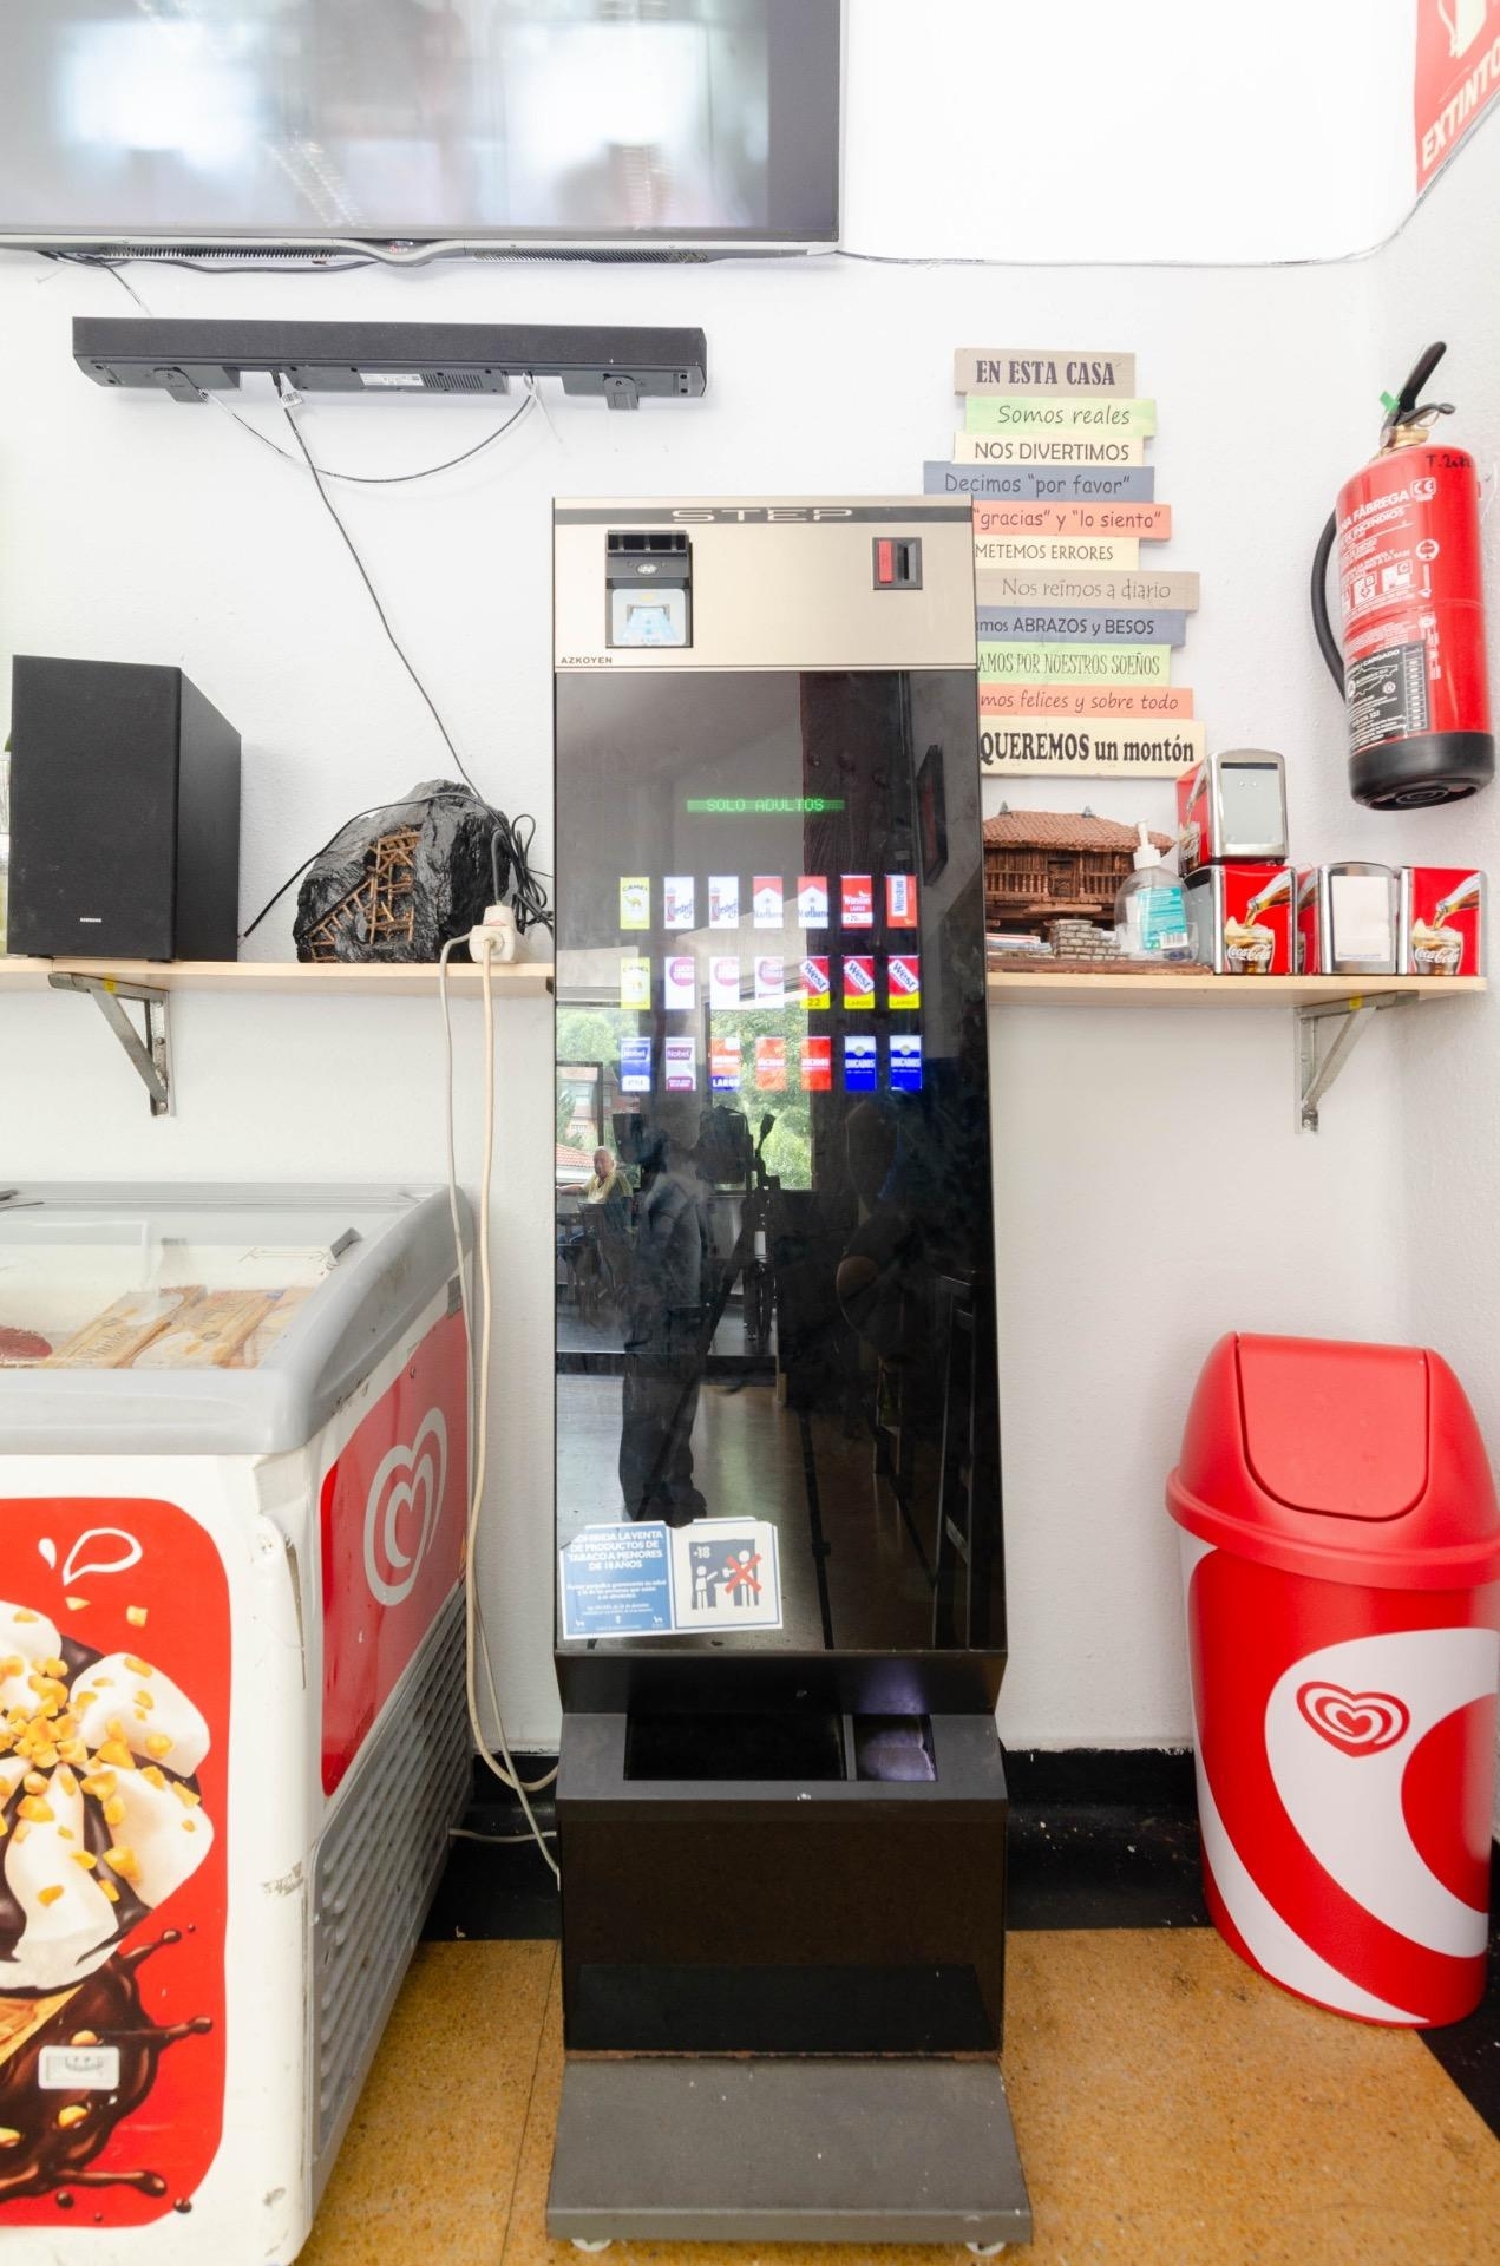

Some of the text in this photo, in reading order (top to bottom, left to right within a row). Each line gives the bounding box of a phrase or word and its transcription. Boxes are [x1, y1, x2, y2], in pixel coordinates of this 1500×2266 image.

[975, 359, 1115, 386] EN ESTA CASA
[998, 405, 1130, 426] Somos reales
[975, 441, 1129, 461] NOS DIVERTIMOS
[945, 473, 1021, 493] Decimos
[672, 509, 853, 523] STEP
[1056, 514, 1066, 531] y
[975, 543, 1114, 561] METEMOS ERRORES
[1002, 578, 1172, 600] Nos reímos a diario
[1013, 617, 1087, 634] ABRAZOS
[1092, 621, 1101, 636] y
[1105, 619, 1154, 635] BESOS
[561, 656, 612, 664] AZKOYEN
[978, 652, 1014, 673] AMOS
[1016, 653, 1040, 674] POR
[981, 689, 1179, 713] mos felices y sobre todo
[980, 732, 1194, 766] QUEREMOS un montón
[706, 799, 825, 812] SOLO ADULTOS
